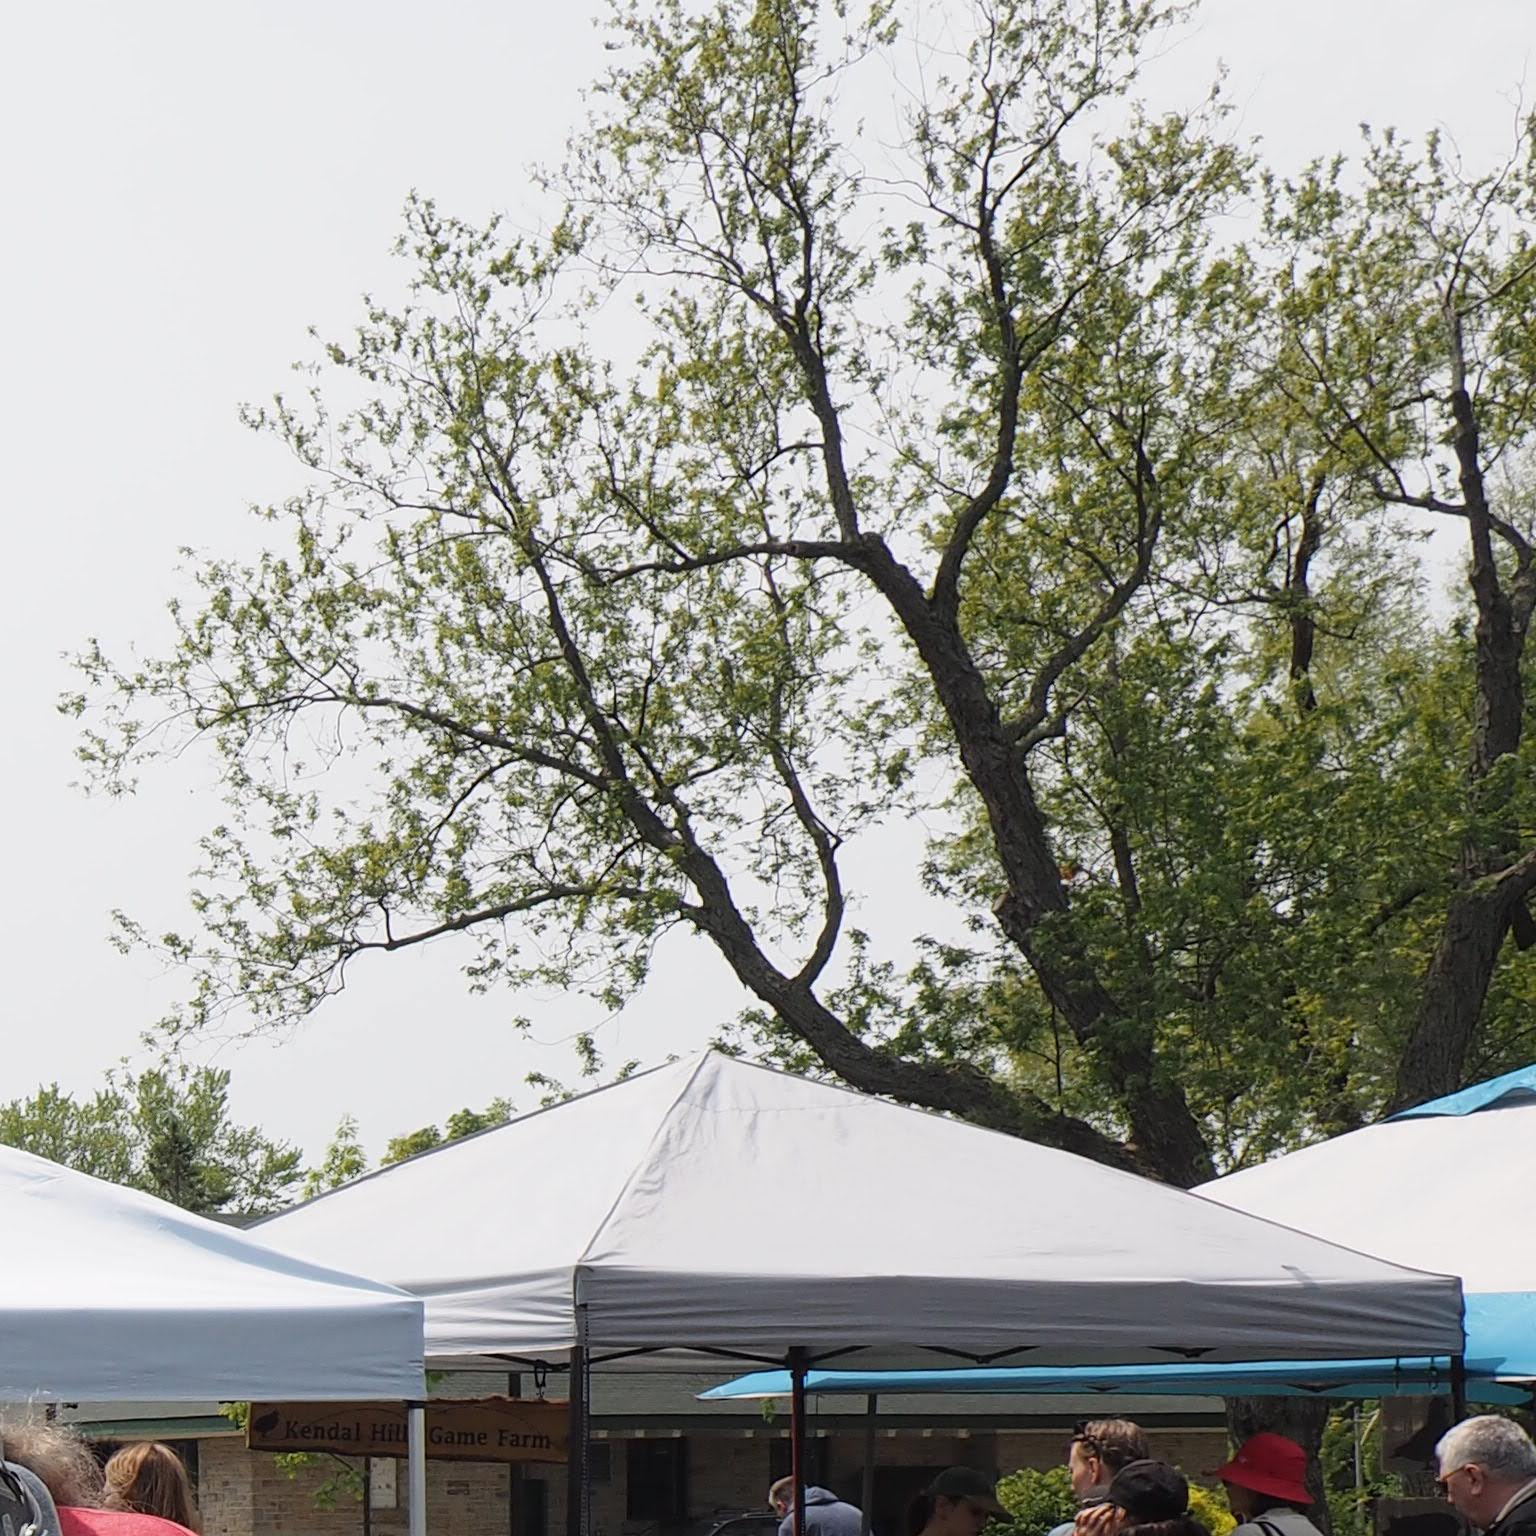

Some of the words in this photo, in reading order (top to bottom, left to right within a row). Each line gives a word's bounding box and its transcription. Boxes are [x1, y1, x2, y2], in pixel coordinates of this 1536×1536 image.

[285, 1420, 362, 1442] Kendal
[370, 1424, 408, 1443] Hill
[430, 1426, 488, 1446] Game
[497, 1429, 551, 1449] Farm
